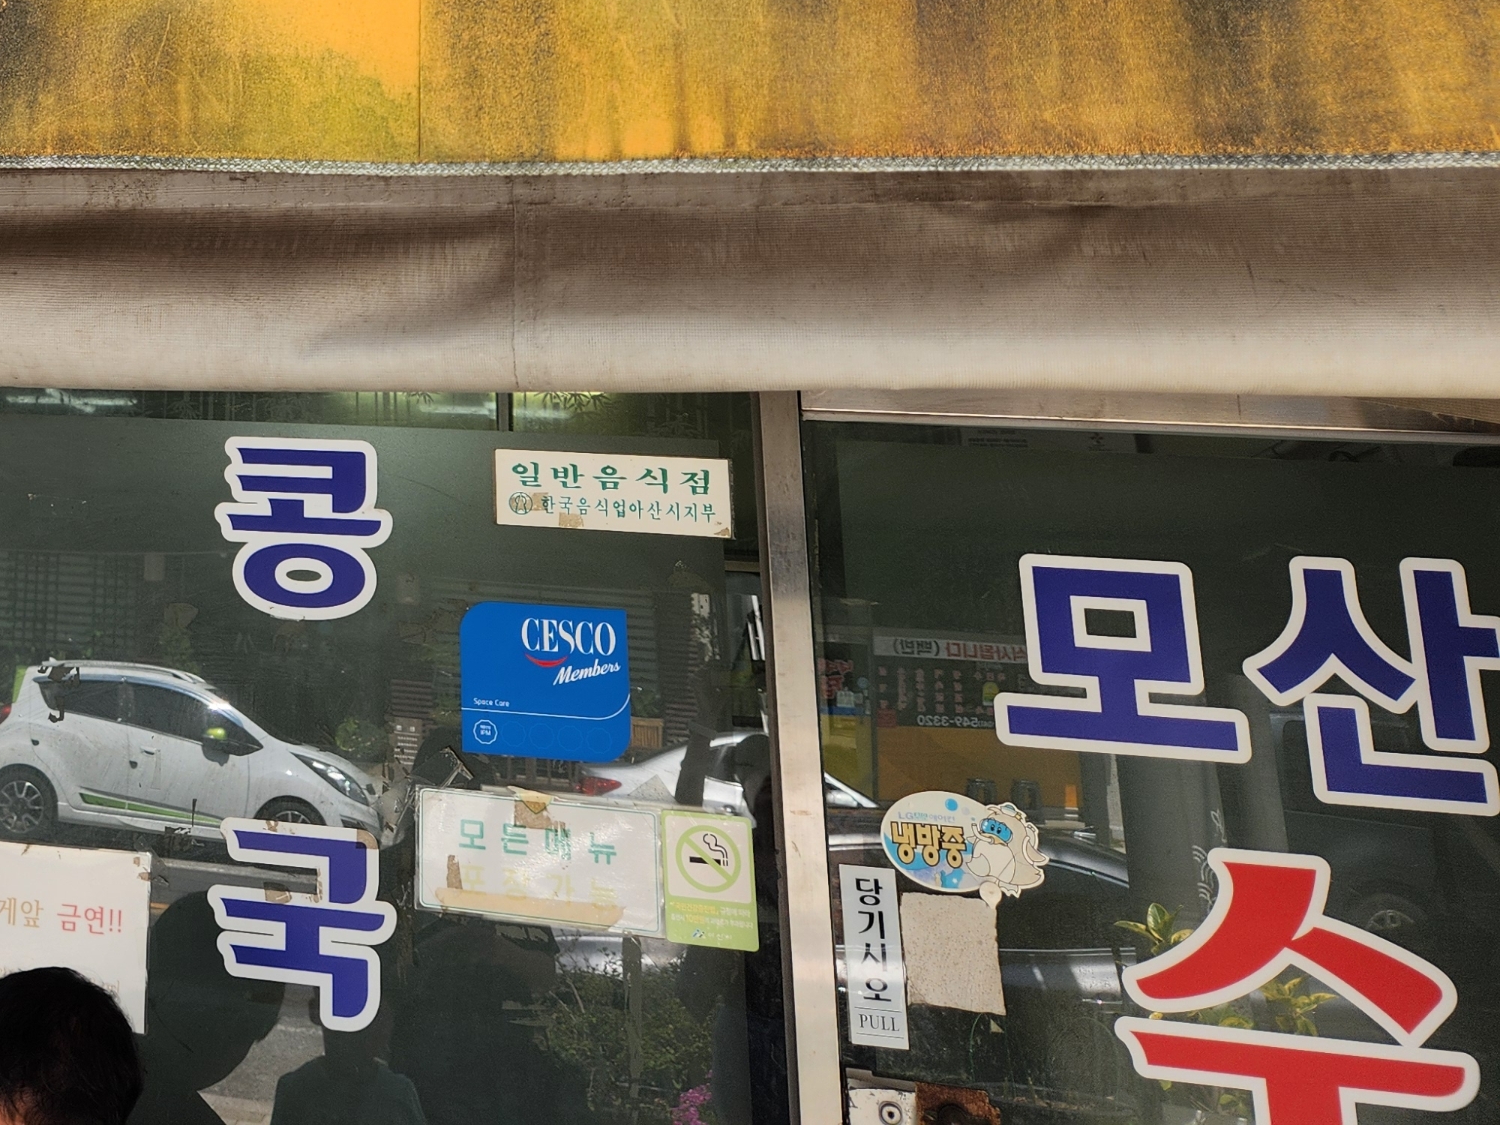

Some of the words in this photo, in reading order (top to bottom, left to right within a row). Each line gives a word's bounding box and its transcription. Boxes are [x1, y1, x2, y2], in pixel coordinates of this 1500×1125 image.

[512, 461, 711, 496] 일반음식점
[521, 617, 617, 656] CESCO
[553, 659, 622, 686] Members
[993, 553, 1500, 817] 모산
[473, 697, 493, 706] Space
[494, 699, 510, 707] Care
[889, 820, 968, 869] 냉방중
[56, 903, 123, 935] 금연!!
[854, 877, 892, 1003] 당기시오
[858, 1013, 901, 1032] PULL
